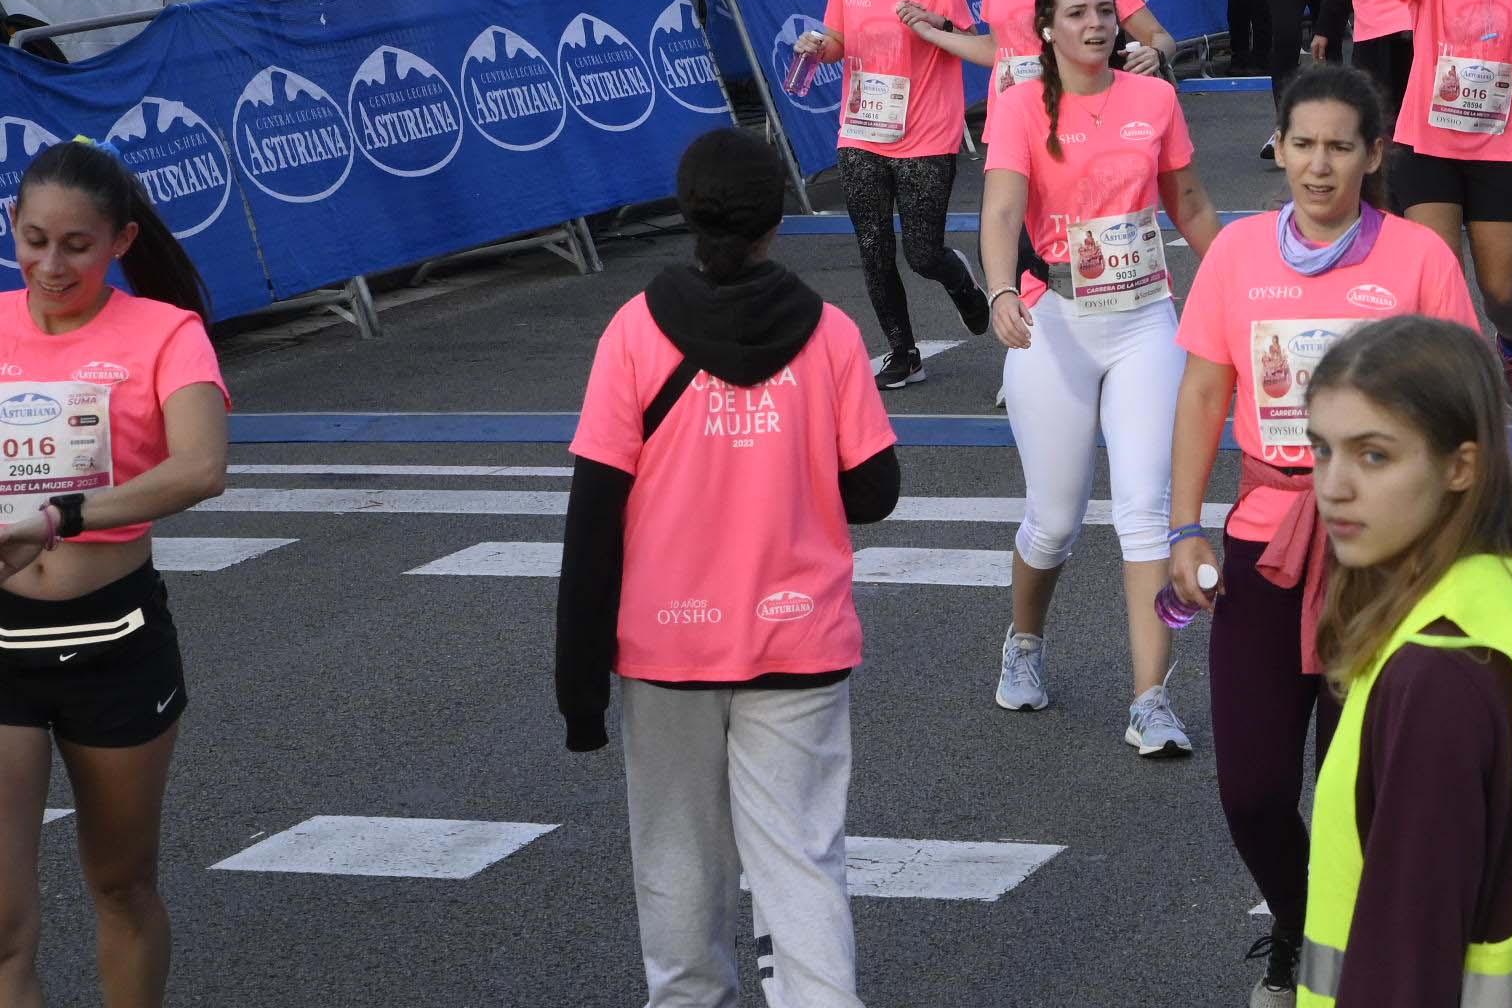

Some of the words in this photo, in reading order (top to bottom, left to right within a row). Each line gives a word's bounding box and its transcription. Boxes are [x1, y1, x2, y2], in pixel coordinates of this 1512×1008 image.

[659, 46, 721, 89] ASTUR
[566, 61, 651, 106] ASTURIANA
[471, 76, 563, 126] ASTURIANA
[1462, 87, 1487, 100] 016
[861, 99, 883, 111] 016
[358, 100, 459, 150] ASTURIANA
[244, 123, 349, 176] ASTURIANA
[1108, 250, 1141, 269] 016
[1115, 269, 1137, 281] 9033
[1087, 283, 1116, 295] CARRERA
[1116, 282, 1125, 290] DE
[1126, 280, 1135, 289] LA
[1249, 286, 1303, 300] OYSHO
[1084, 298, 1118, 310] OYSHO
[67, 396, 97, 406] SUMA
[709, 390, 736, 413] DE
[746, 388, 775, 410] LA
[2, 406, 57, 419] ASTURIANA
[1270, 409, 1303, 418] CARRERA
[704, 412, 781, 436] MUJER
[1270, 425, 1304, 436] OYSHO
[3, 436, 56, 458] 016
[9, 463, 51, 477] 29049
[13, 482, 28, 491] DE
[28, 482, 40, 491] LA
[42, 481, 73, 490] MUJER
[657, 607, 722, 624] OYSHO
[761, 601, 812, 616] ASTURIANA
